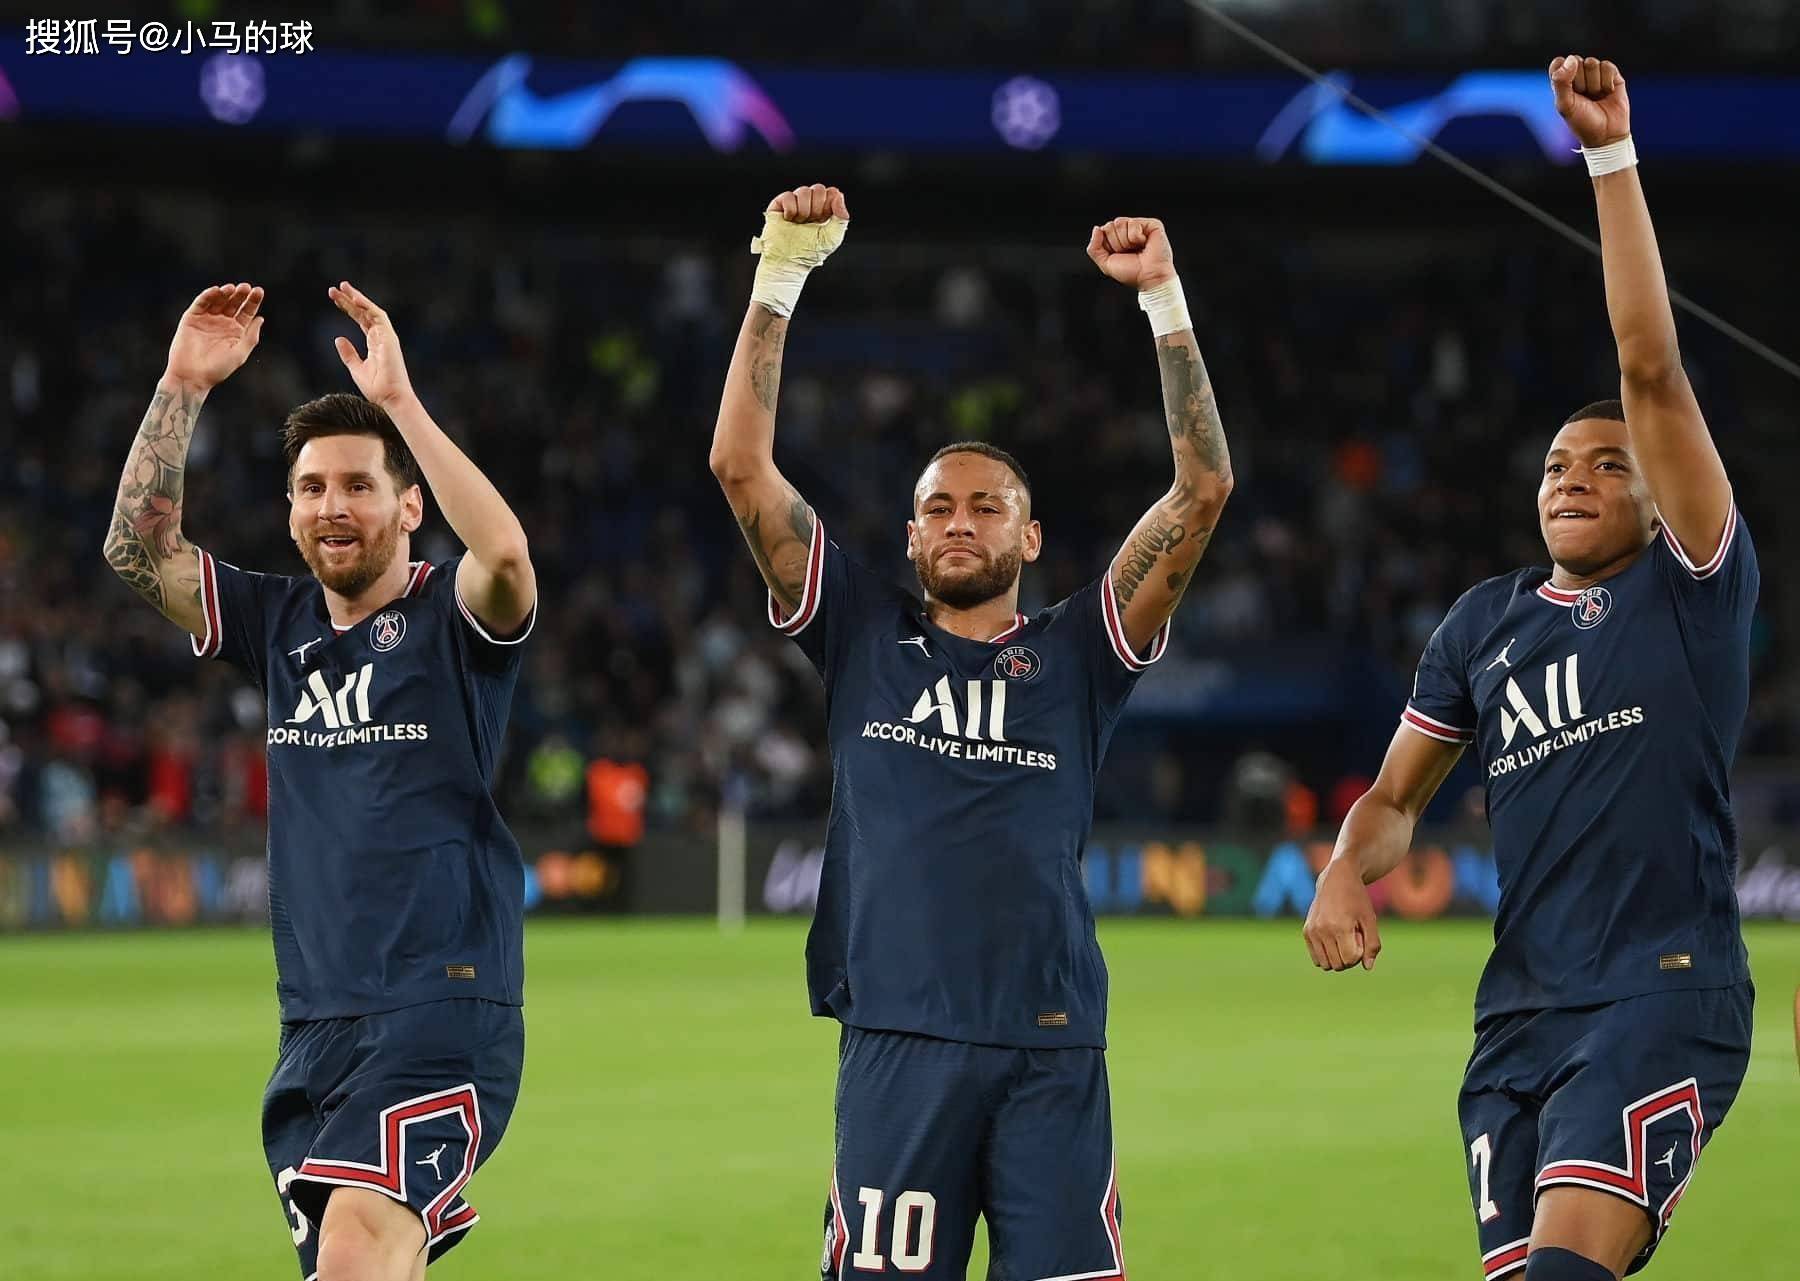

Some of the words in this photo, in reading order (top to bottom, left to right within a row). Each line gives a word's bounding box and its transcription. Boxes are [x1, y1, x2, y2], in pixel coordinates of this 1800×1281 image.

[997, 648, 1025, 664] PARIS
[267, 727, 300, 745] COR
[303, 729, 338, 749] LIVE
[337, 723, 429, 747] LIMITLESS
[861, 721, 917, 745] ACCOR
[919, 734, 962, 758] LIVE
[965, 743, 1057, 771] LIMITLESS
[1519, 739, 1551, 768] LIVE
[1553, 706, 1645, 751] LIMITLESS
[1470, 1132, 1500, 1224] 7
[853, 1186, 938, 1273] 10
